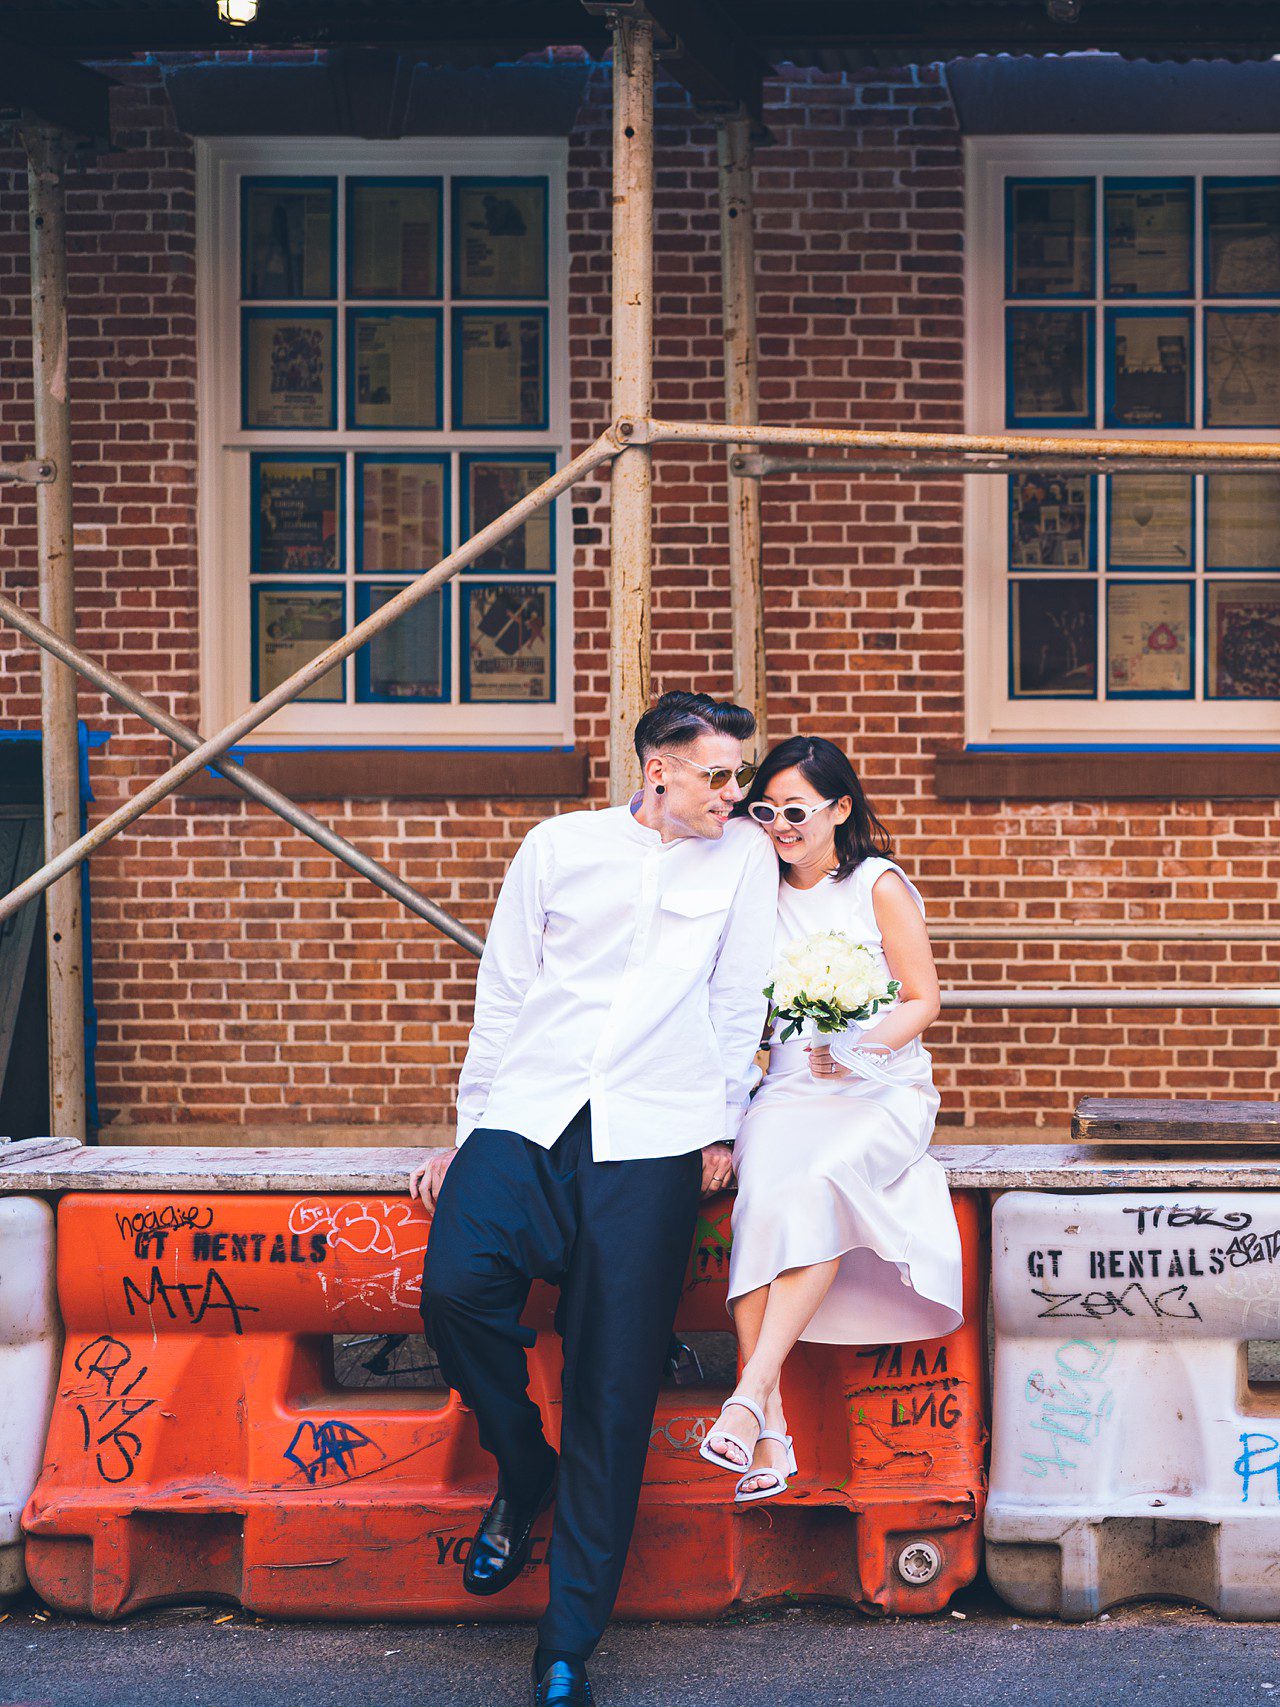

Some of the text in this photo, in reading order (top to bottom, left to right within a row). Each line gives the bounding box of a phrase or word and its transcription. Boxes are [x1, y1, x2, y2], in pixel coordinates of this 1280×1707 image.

[1027, 1248, 1226, 1279] GT RENTALS
[122, 1265, 260, 1335] MTA
